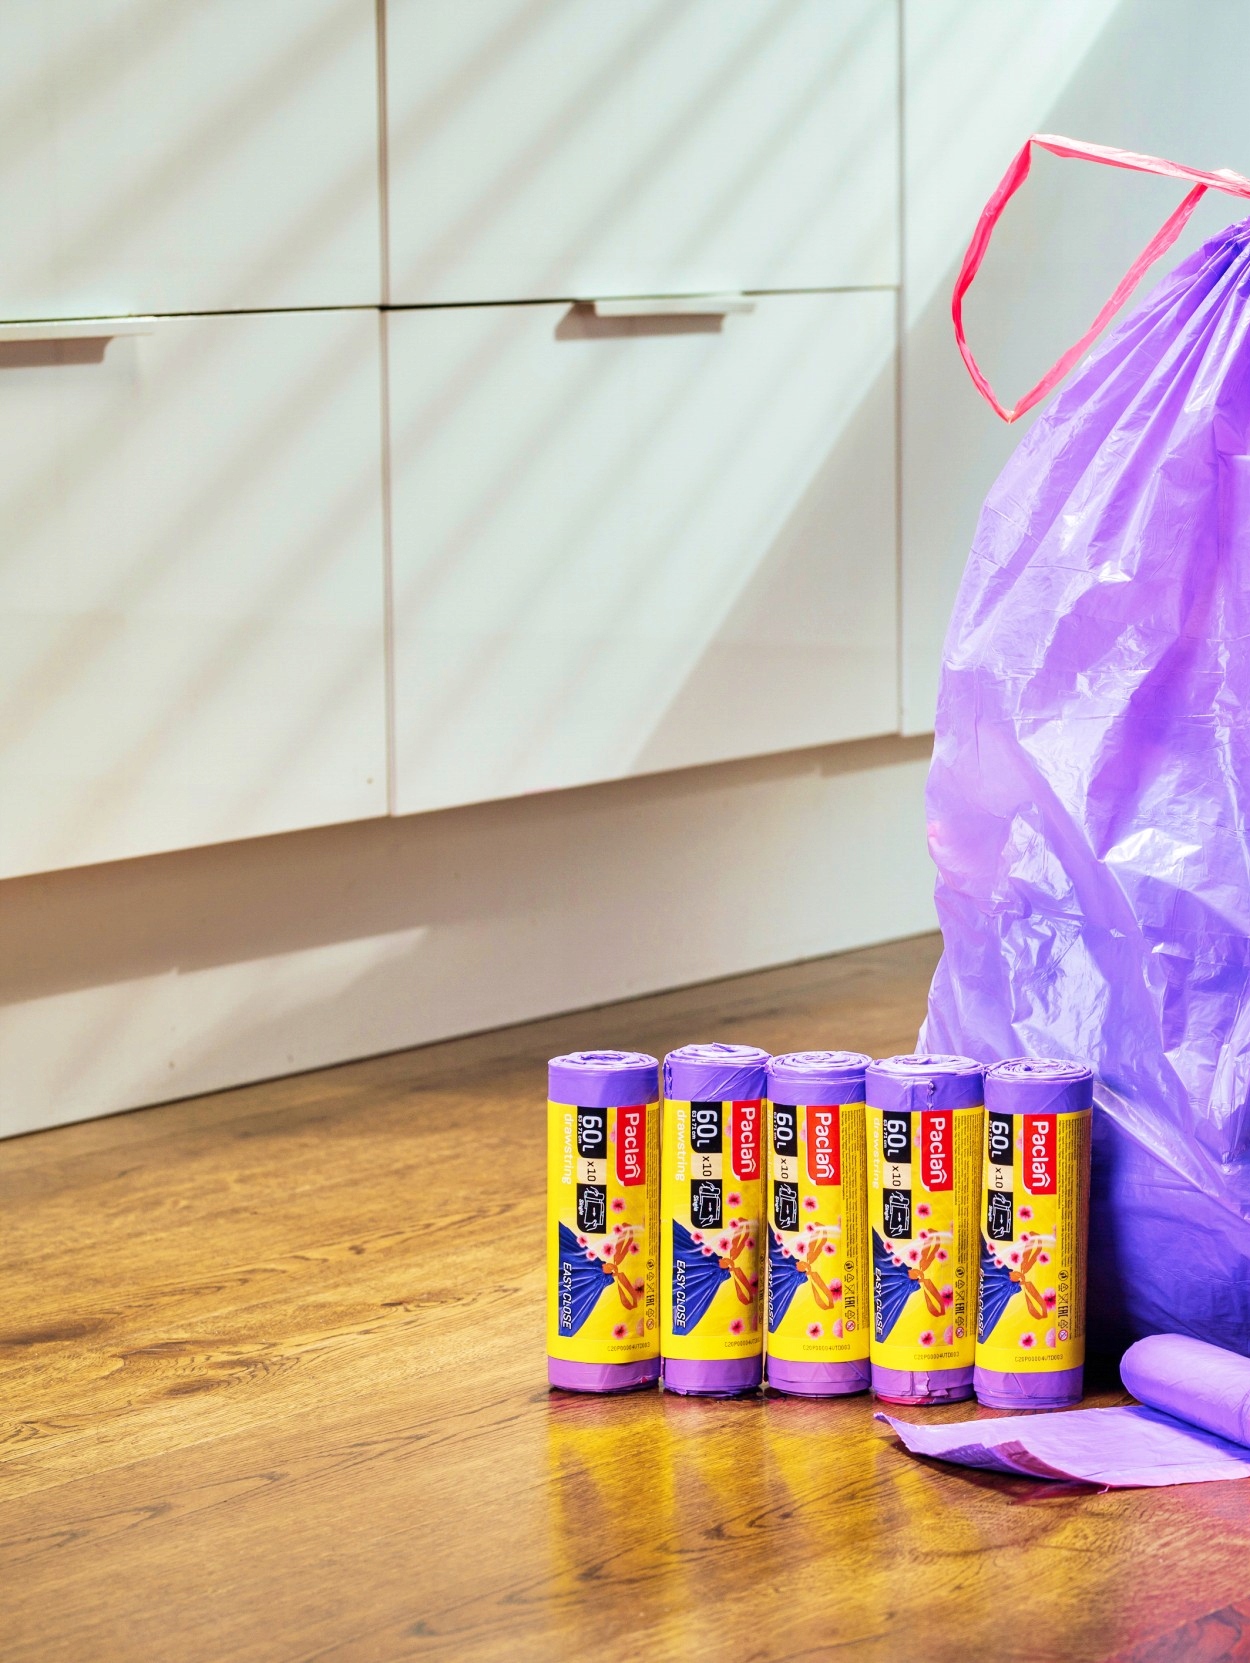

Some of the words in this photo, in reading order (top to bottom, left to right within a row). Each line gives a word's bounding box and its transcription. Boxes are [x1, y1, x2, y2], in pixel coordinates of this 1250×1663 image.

[562, 1113, 574, 1185] drawstring
[675, 1109, 687, 1182] drawstring
[872, 1117, 881, 1190] drawstring
[563, 1261, 572, 1292] EASY
[676, 1259, 686, 1290] EASY
[563, 1292, 572, 1330] CLOSE
[676, 1291, 686, 1328] CLOSE
[875, 1297, 883, 1335] CLOSE
